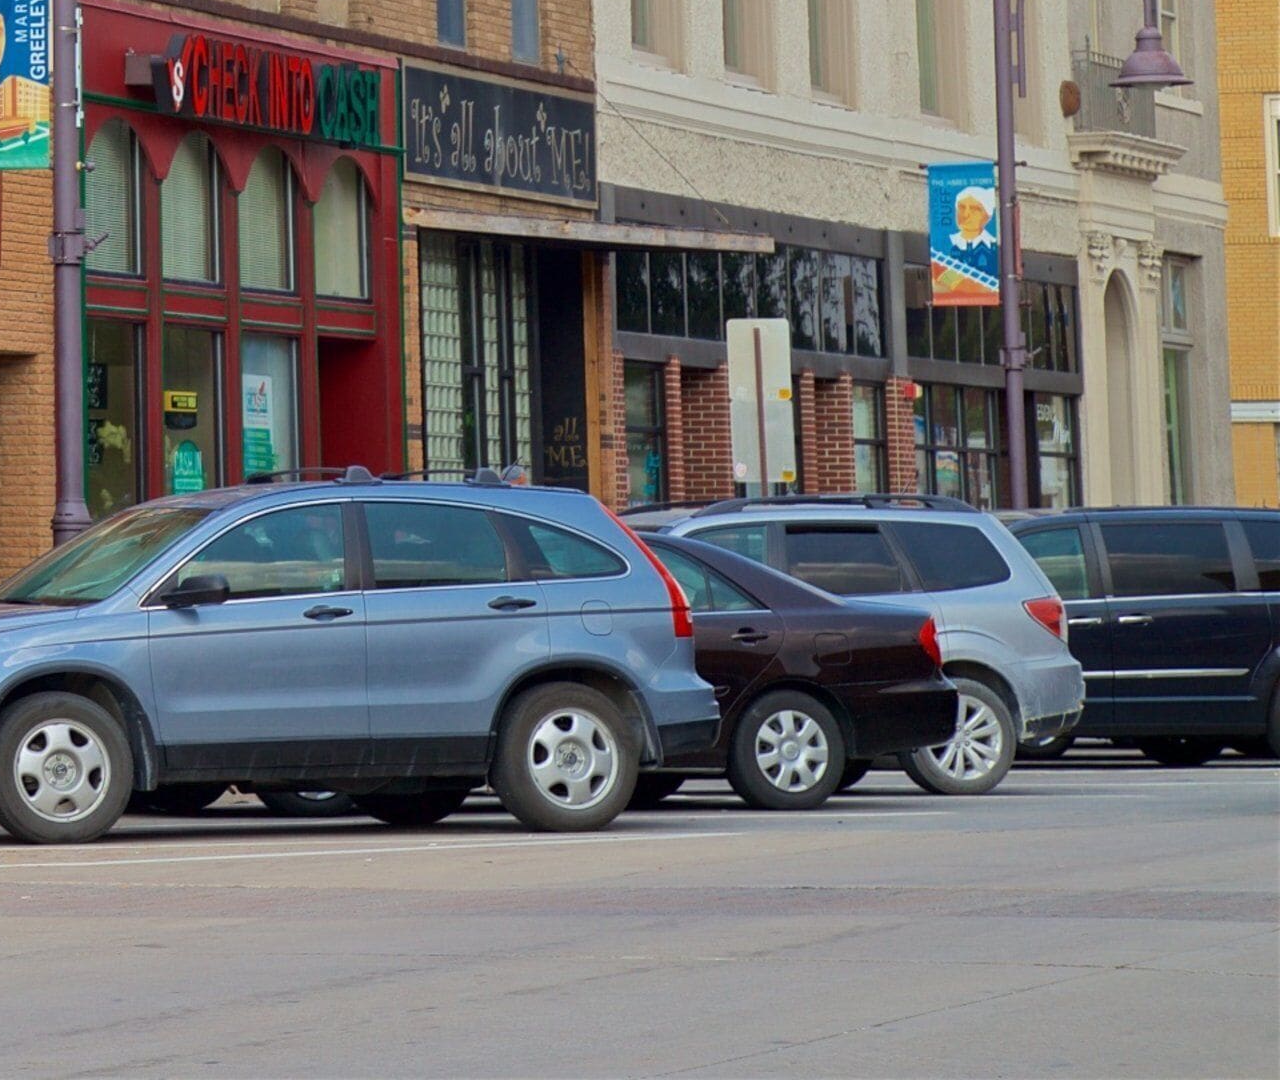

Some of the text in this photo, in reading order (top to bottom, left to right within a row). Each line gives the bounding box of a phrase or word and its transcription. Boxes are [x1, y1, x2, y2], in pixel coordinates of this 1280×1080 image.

[192, 34, 262, 127] CHECK
[269, 51, 315, 136] INTO
[320, 63, 382, 148] CASH
[450, 99, 477, 173] all
[484, 104, 541, 184] about
[546, 126, 590, 192] ME!
